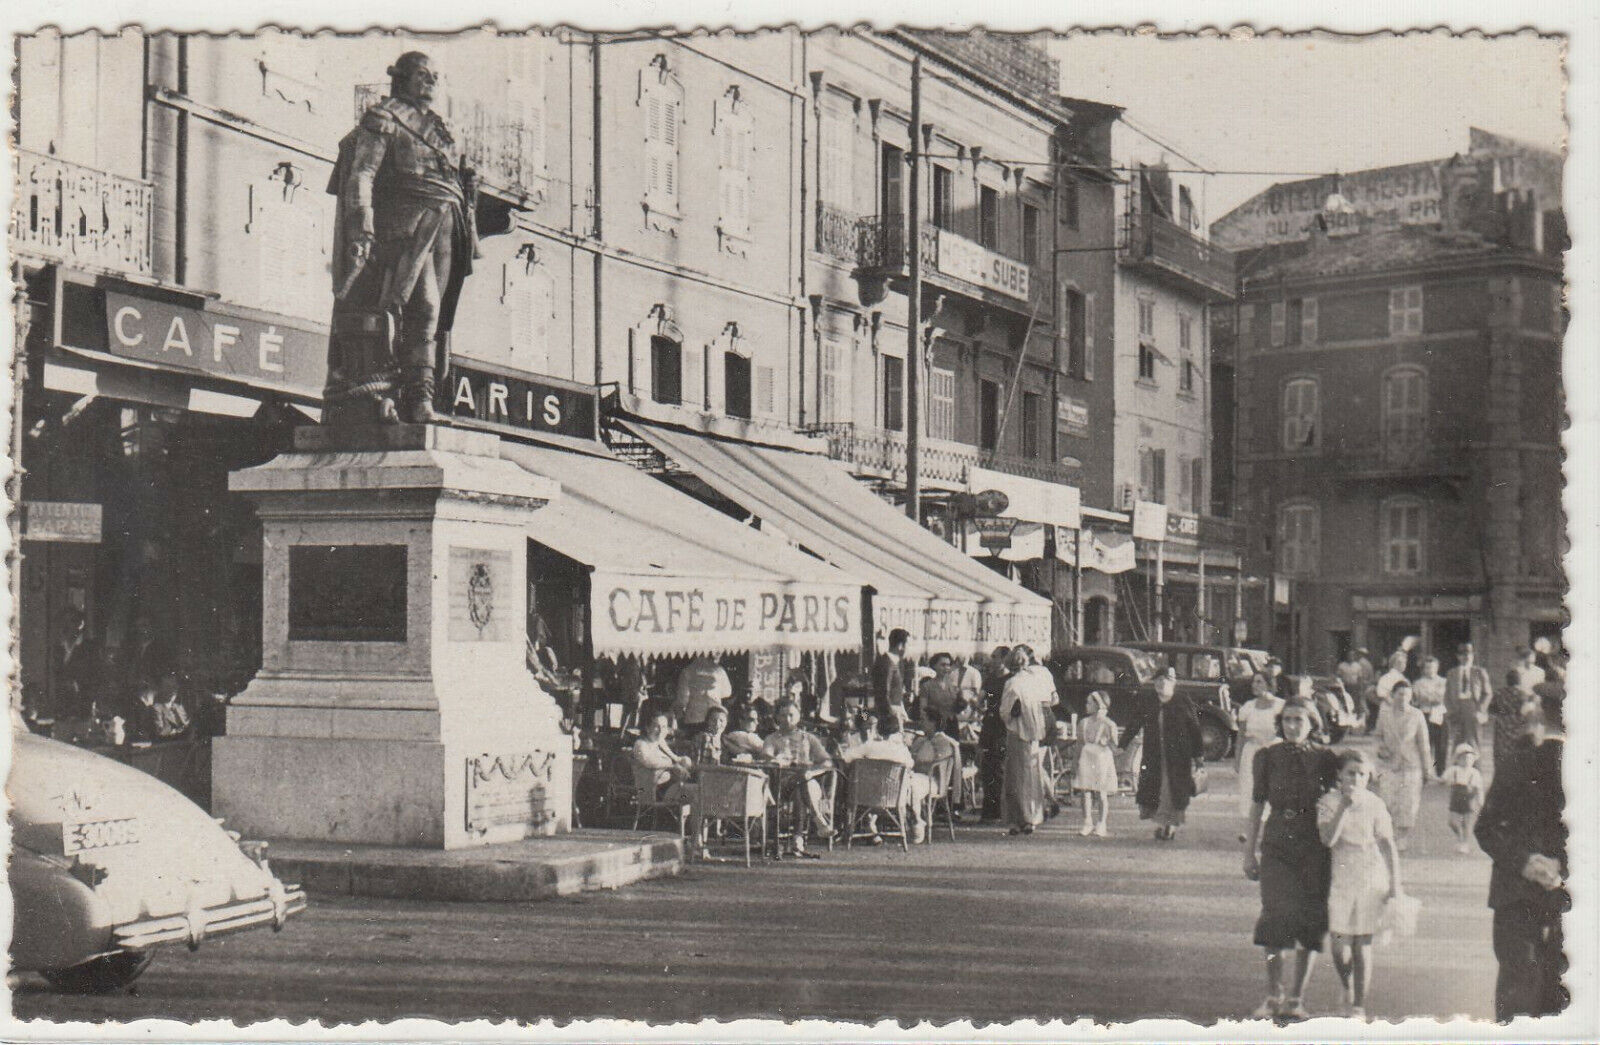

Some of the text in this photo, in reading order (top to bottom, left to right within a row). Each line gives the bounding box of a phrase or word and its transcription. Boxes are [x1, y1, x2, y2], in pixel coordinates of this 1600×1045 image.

[993, 259, 1026, 295] SUBE
[114, 306, 561, 426] CAFÉ ARIS
[608, 587, 849, 634] CAFÉ DE PARIS
